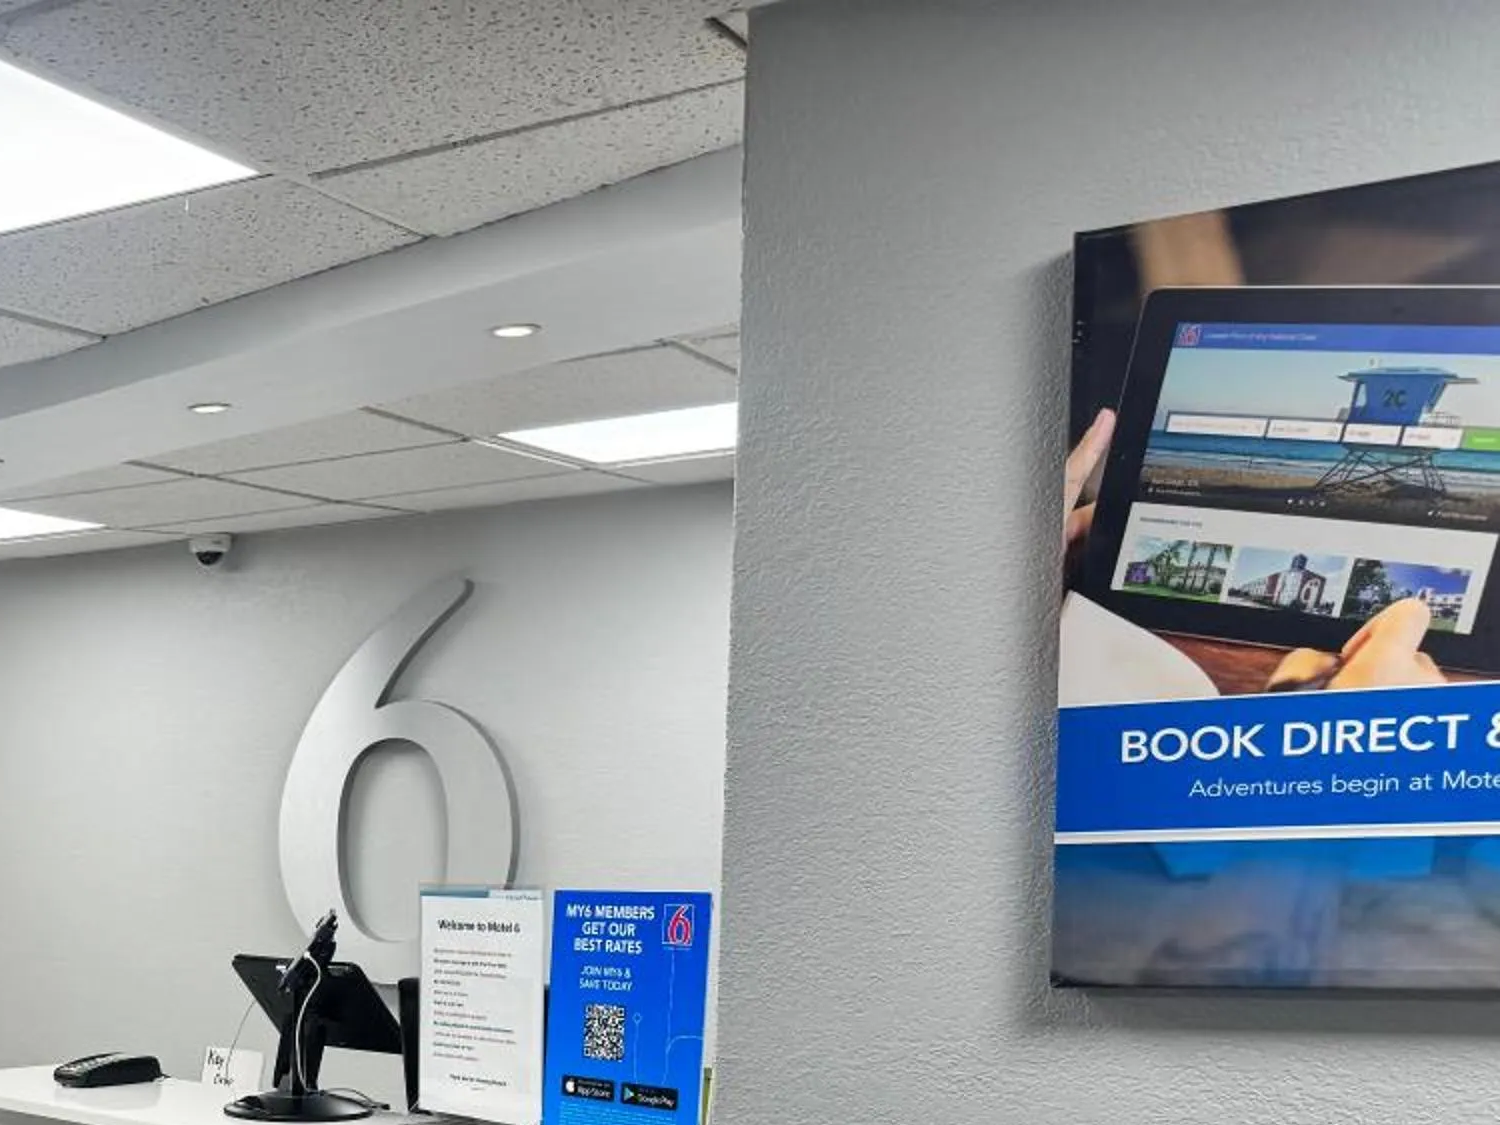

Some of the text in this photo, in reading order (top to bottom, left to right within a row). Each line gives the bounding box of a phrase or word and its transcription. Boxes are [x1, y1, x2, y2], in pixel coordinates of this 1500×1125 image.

[1121, 724, 1265, 764] BOOK
[1282, 714, 1470, 757] DIRECT
[278, 574, 520, 984] 6
[1188, 777, 1324, 799] Adventures
[1331, 772, 1400, 798] begin
[1408, 773, 1433, 791] at
[594, 904, 655, 921] MEMBERS
[438, 919, 475, 932] Welcome
[581, 921, 637, 937] GET OUR
[573, 937, 643, 955] BEST RATES
